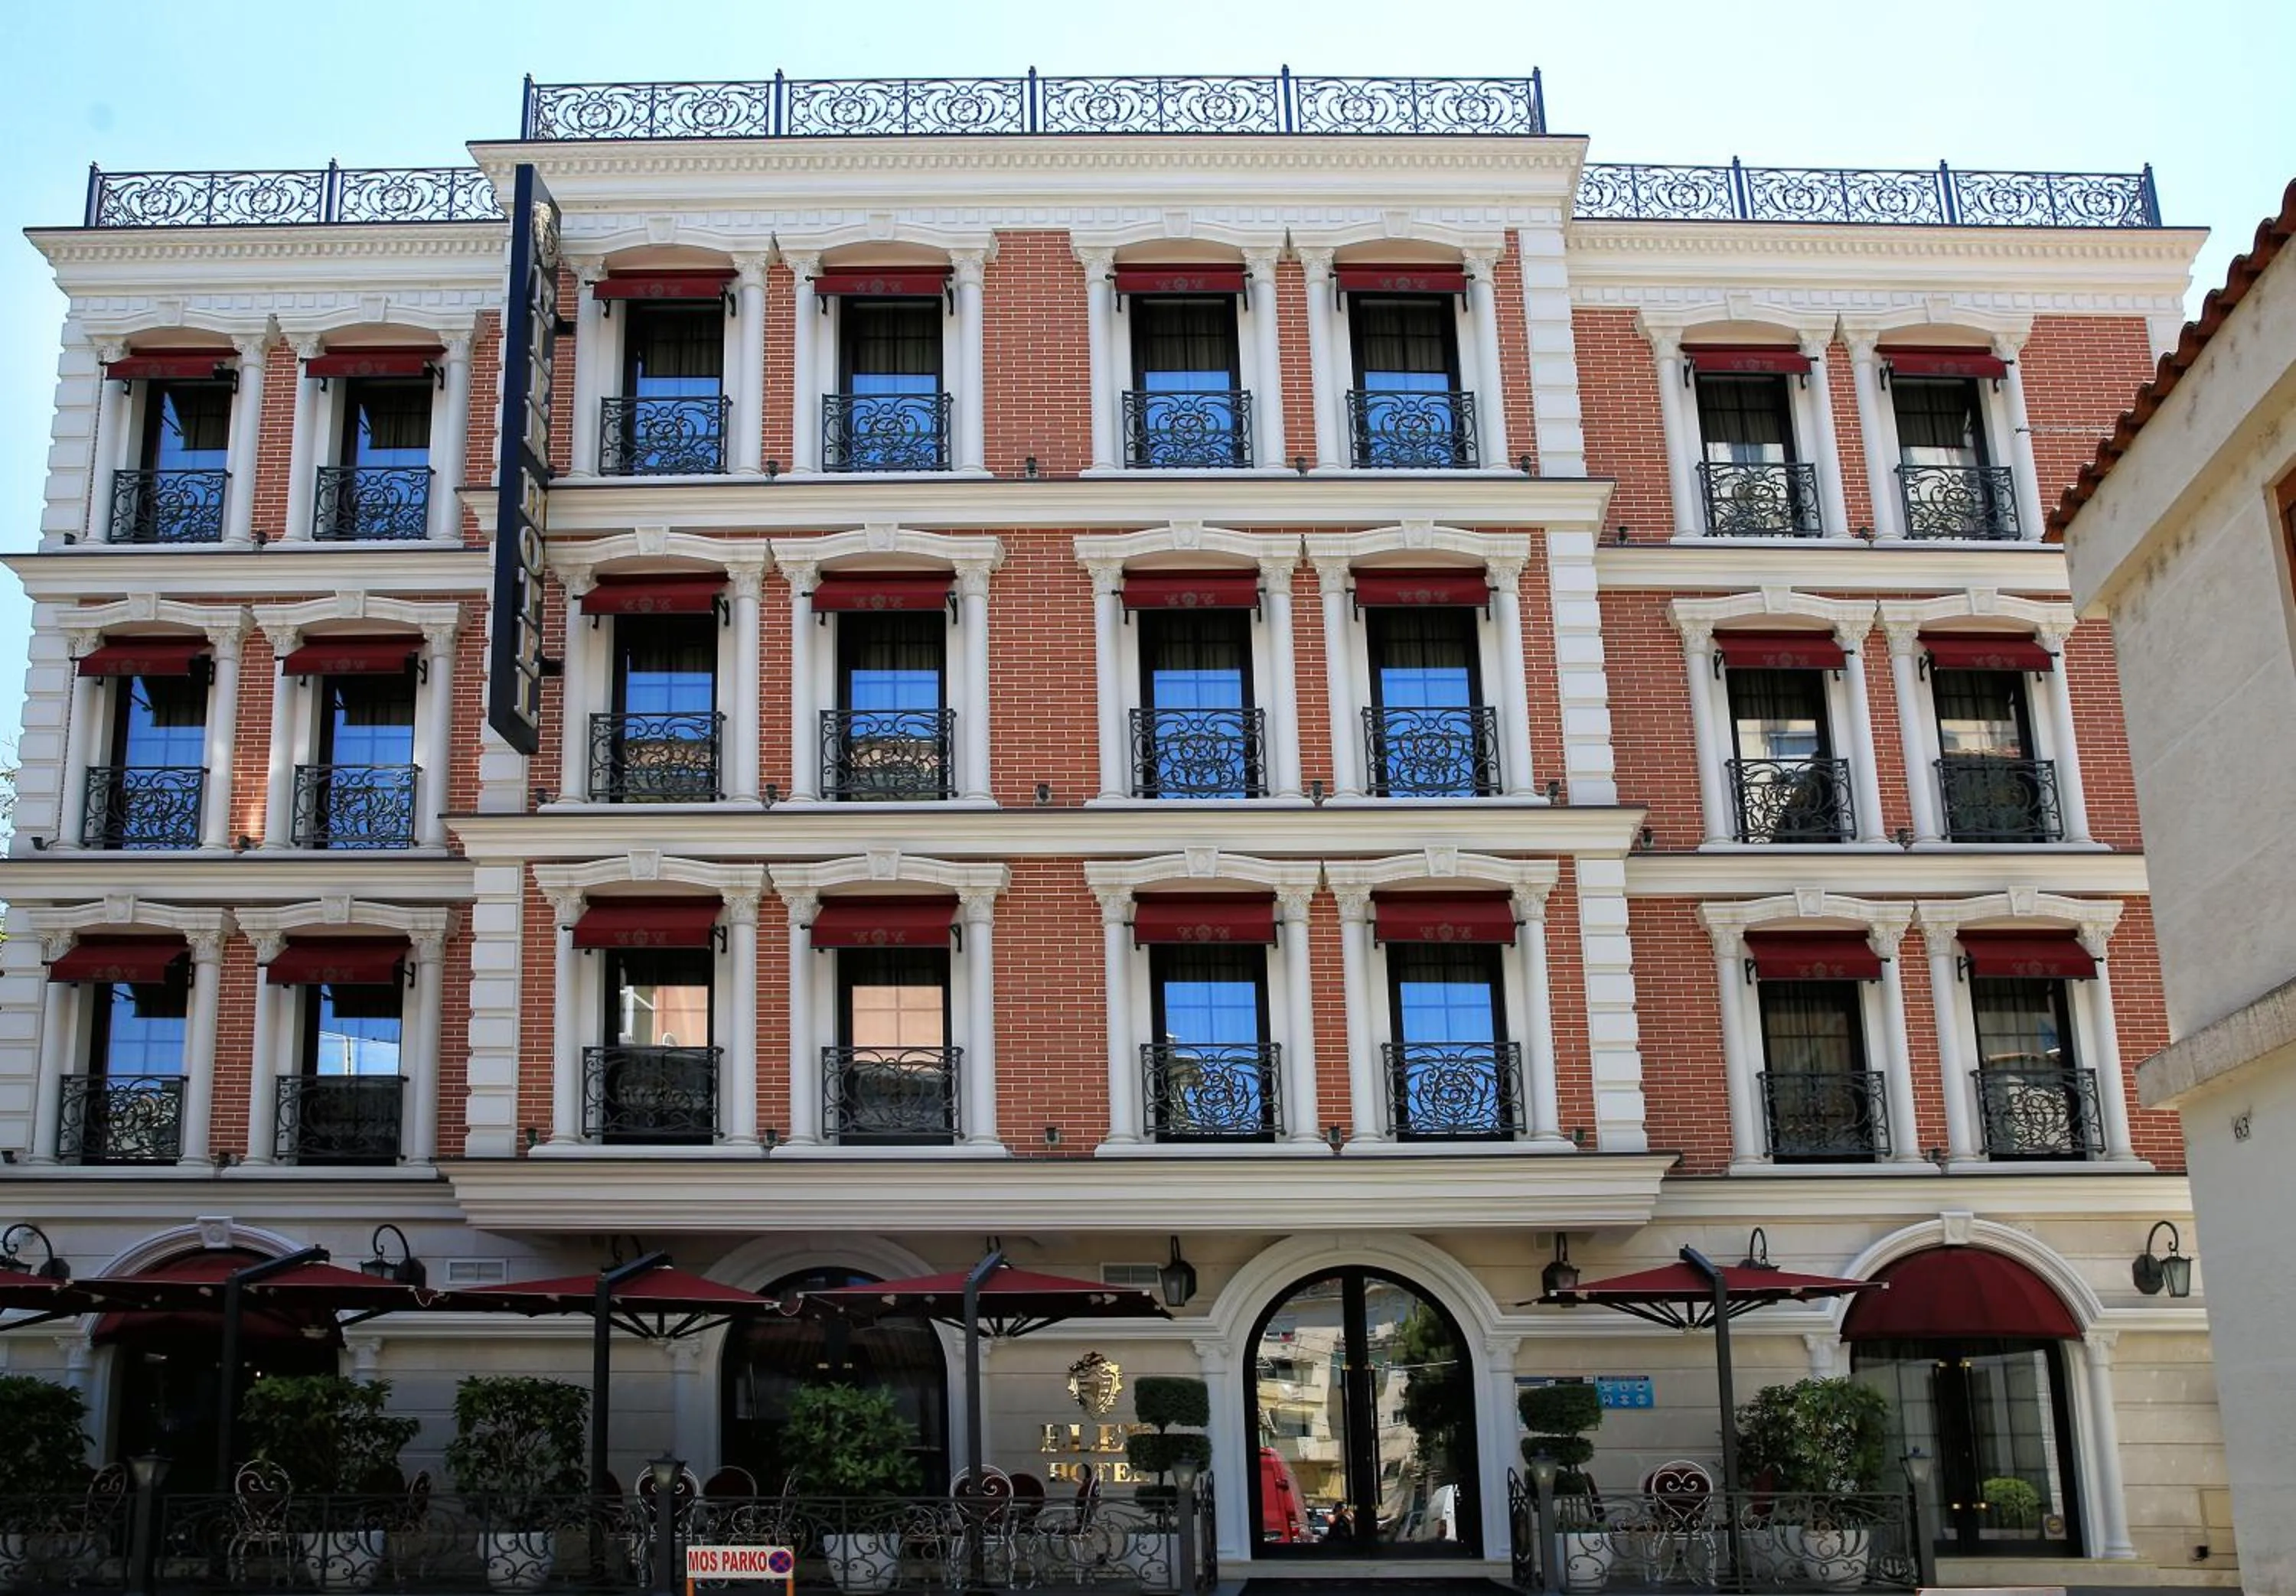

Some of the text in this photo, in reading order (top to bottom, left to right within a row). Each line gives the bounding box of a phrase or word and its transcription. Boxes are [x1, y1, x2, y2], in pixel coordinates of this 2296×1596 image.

[514, 466, 548, 729] HOTEL
[2234, 1116, 2249, 1140] 63
[688, 1551, 767, 1572] MOS PARKO
